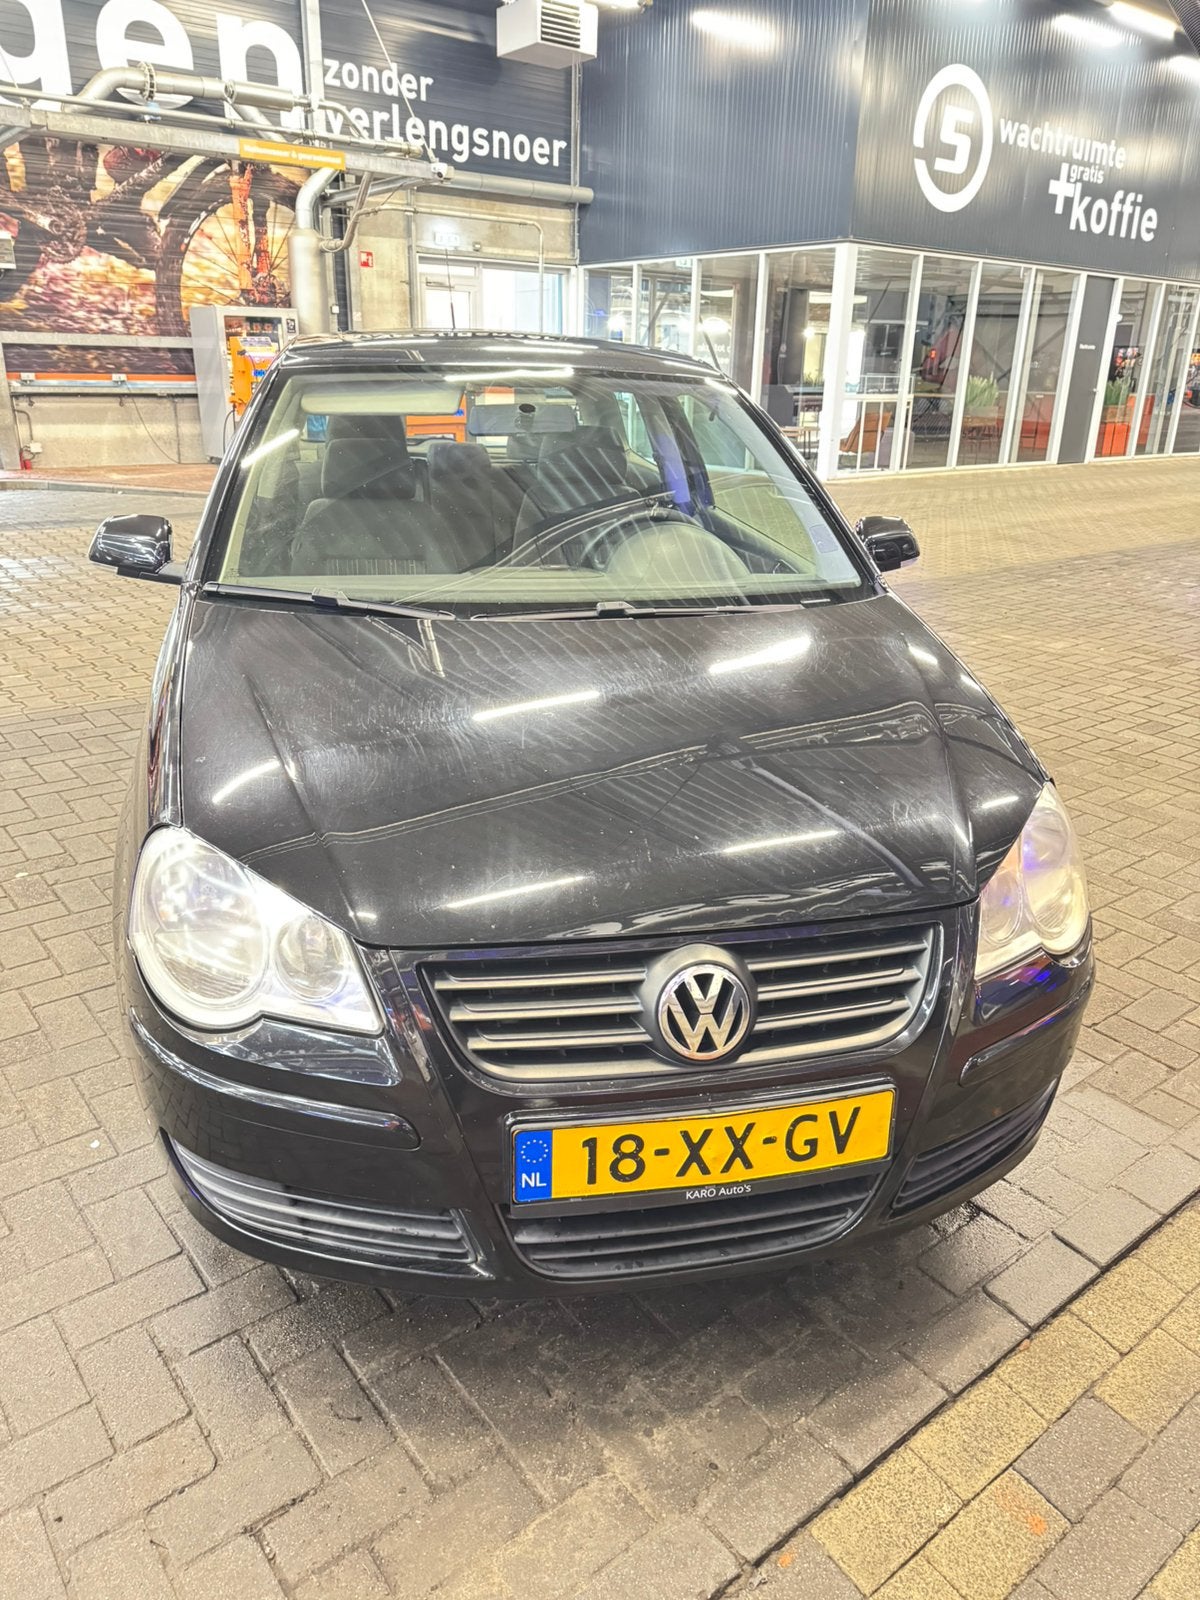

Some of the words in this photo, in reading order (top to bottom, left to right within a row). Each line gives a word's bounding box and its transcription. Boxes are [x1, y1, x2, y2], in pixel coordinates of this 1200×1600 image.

[323, 58, 434, 101] zonder
[323, 104, 567, 167] verlengsnoer
[1000, 118, 1126, 169] wachtruimte
[1070, 164, 1104, 184] gratis
[582, 1106, 862, 1186] 18-XX-GV
[520, 1172, 547, 1189] NL
[685, 1188, 716, 1200] KARO
[718, 1184, 751, 1198] Auto's
